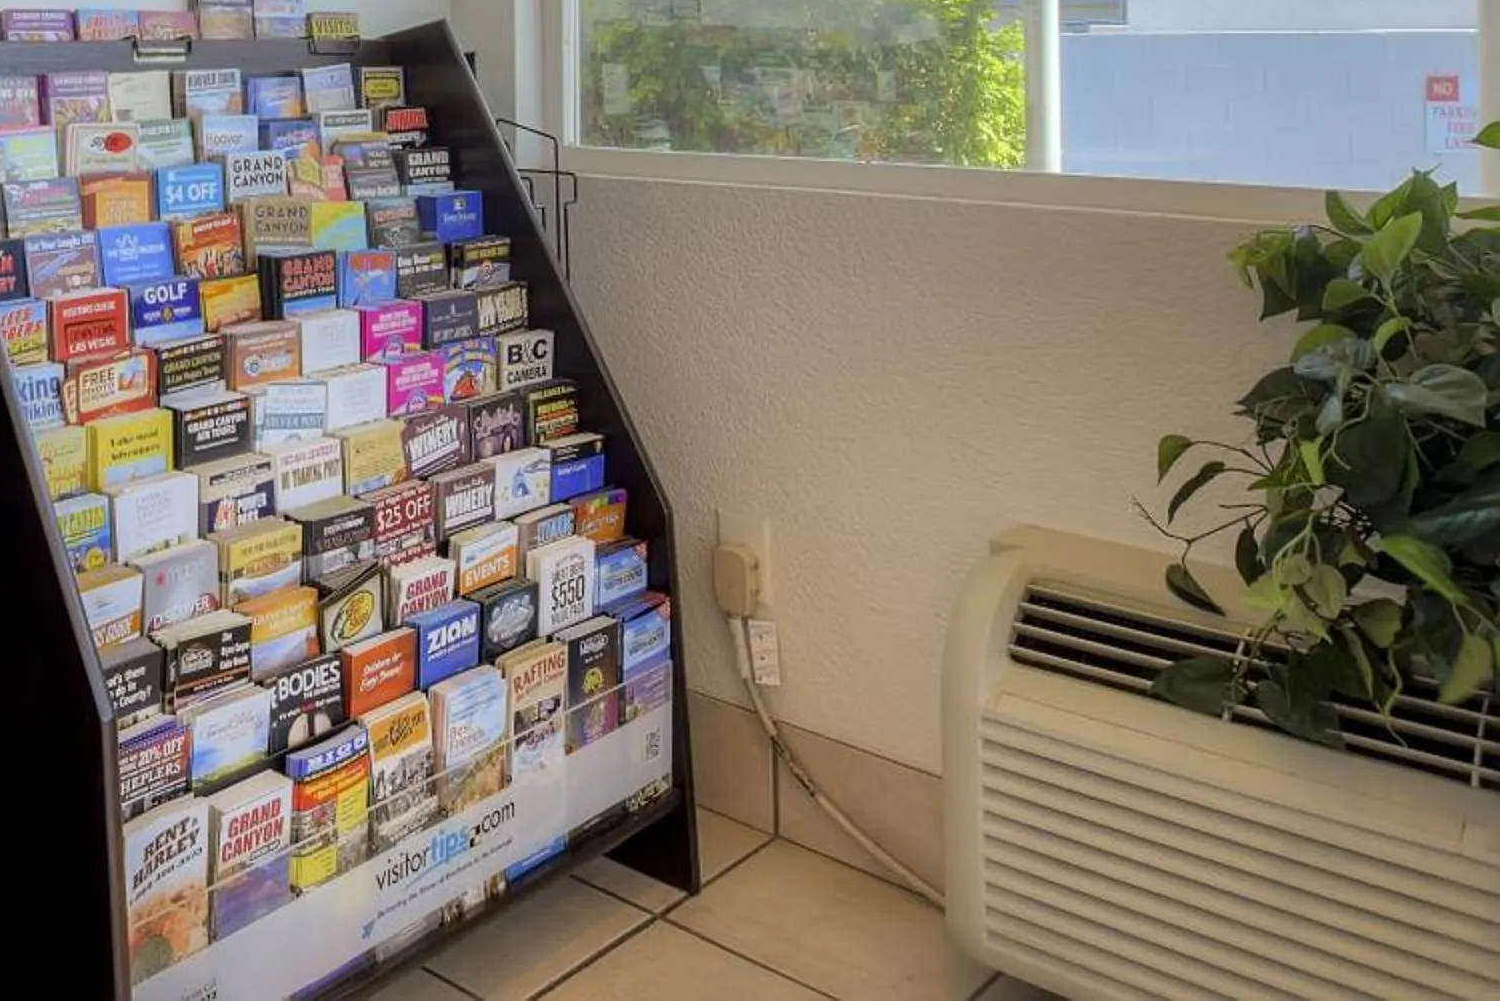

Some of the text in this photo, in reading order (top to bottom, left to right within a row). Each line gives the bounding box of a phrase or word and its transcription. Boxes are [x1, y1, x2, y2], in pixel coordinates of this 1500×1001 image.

[233, 154, 283, 173] GRAND
[408, 151, 449, 165] GRAND
[409, 165, 451, 177] CANYON
[165, 182, 218, 204] $4 OFF
[233, 171, 283, 188] CANYON
[256, 204, 309, 218] GRAND
[255, 220, 309, 234] CANYON
[283, 254, 334, 274] GRAND
[143, 282, 188, 305] GOLF
[283, 270, 335, 292] CANYON
[82, 366, 116, 387] FREE
[507, 364, 548, 384] CAMERA
[408, 417, 459, 457] WINERY
[376, 505, 403, 533] $25
[405, 494, 432, 520] OFF
[445, 482, 494, 516] WINERY
[406, 570, 449, 600] GRAND
[465, 553, 510, 588] EVENTS
[400, 586, 450, 616] CANYON
[551, 574, 586, 611] $550
[426, 612, 478, 655] ZION
[278, 659, 341, 701] BODIES
[512, 650, 566, 693] RAFTING
[163, 736, 185, 757] OFF
[227, 796, 282, 840] GRAND
[142, 816, 191, 863] RENT
[221, 815, 285, 863] CANYON
[132, 827, 200, 891] HARLEY
